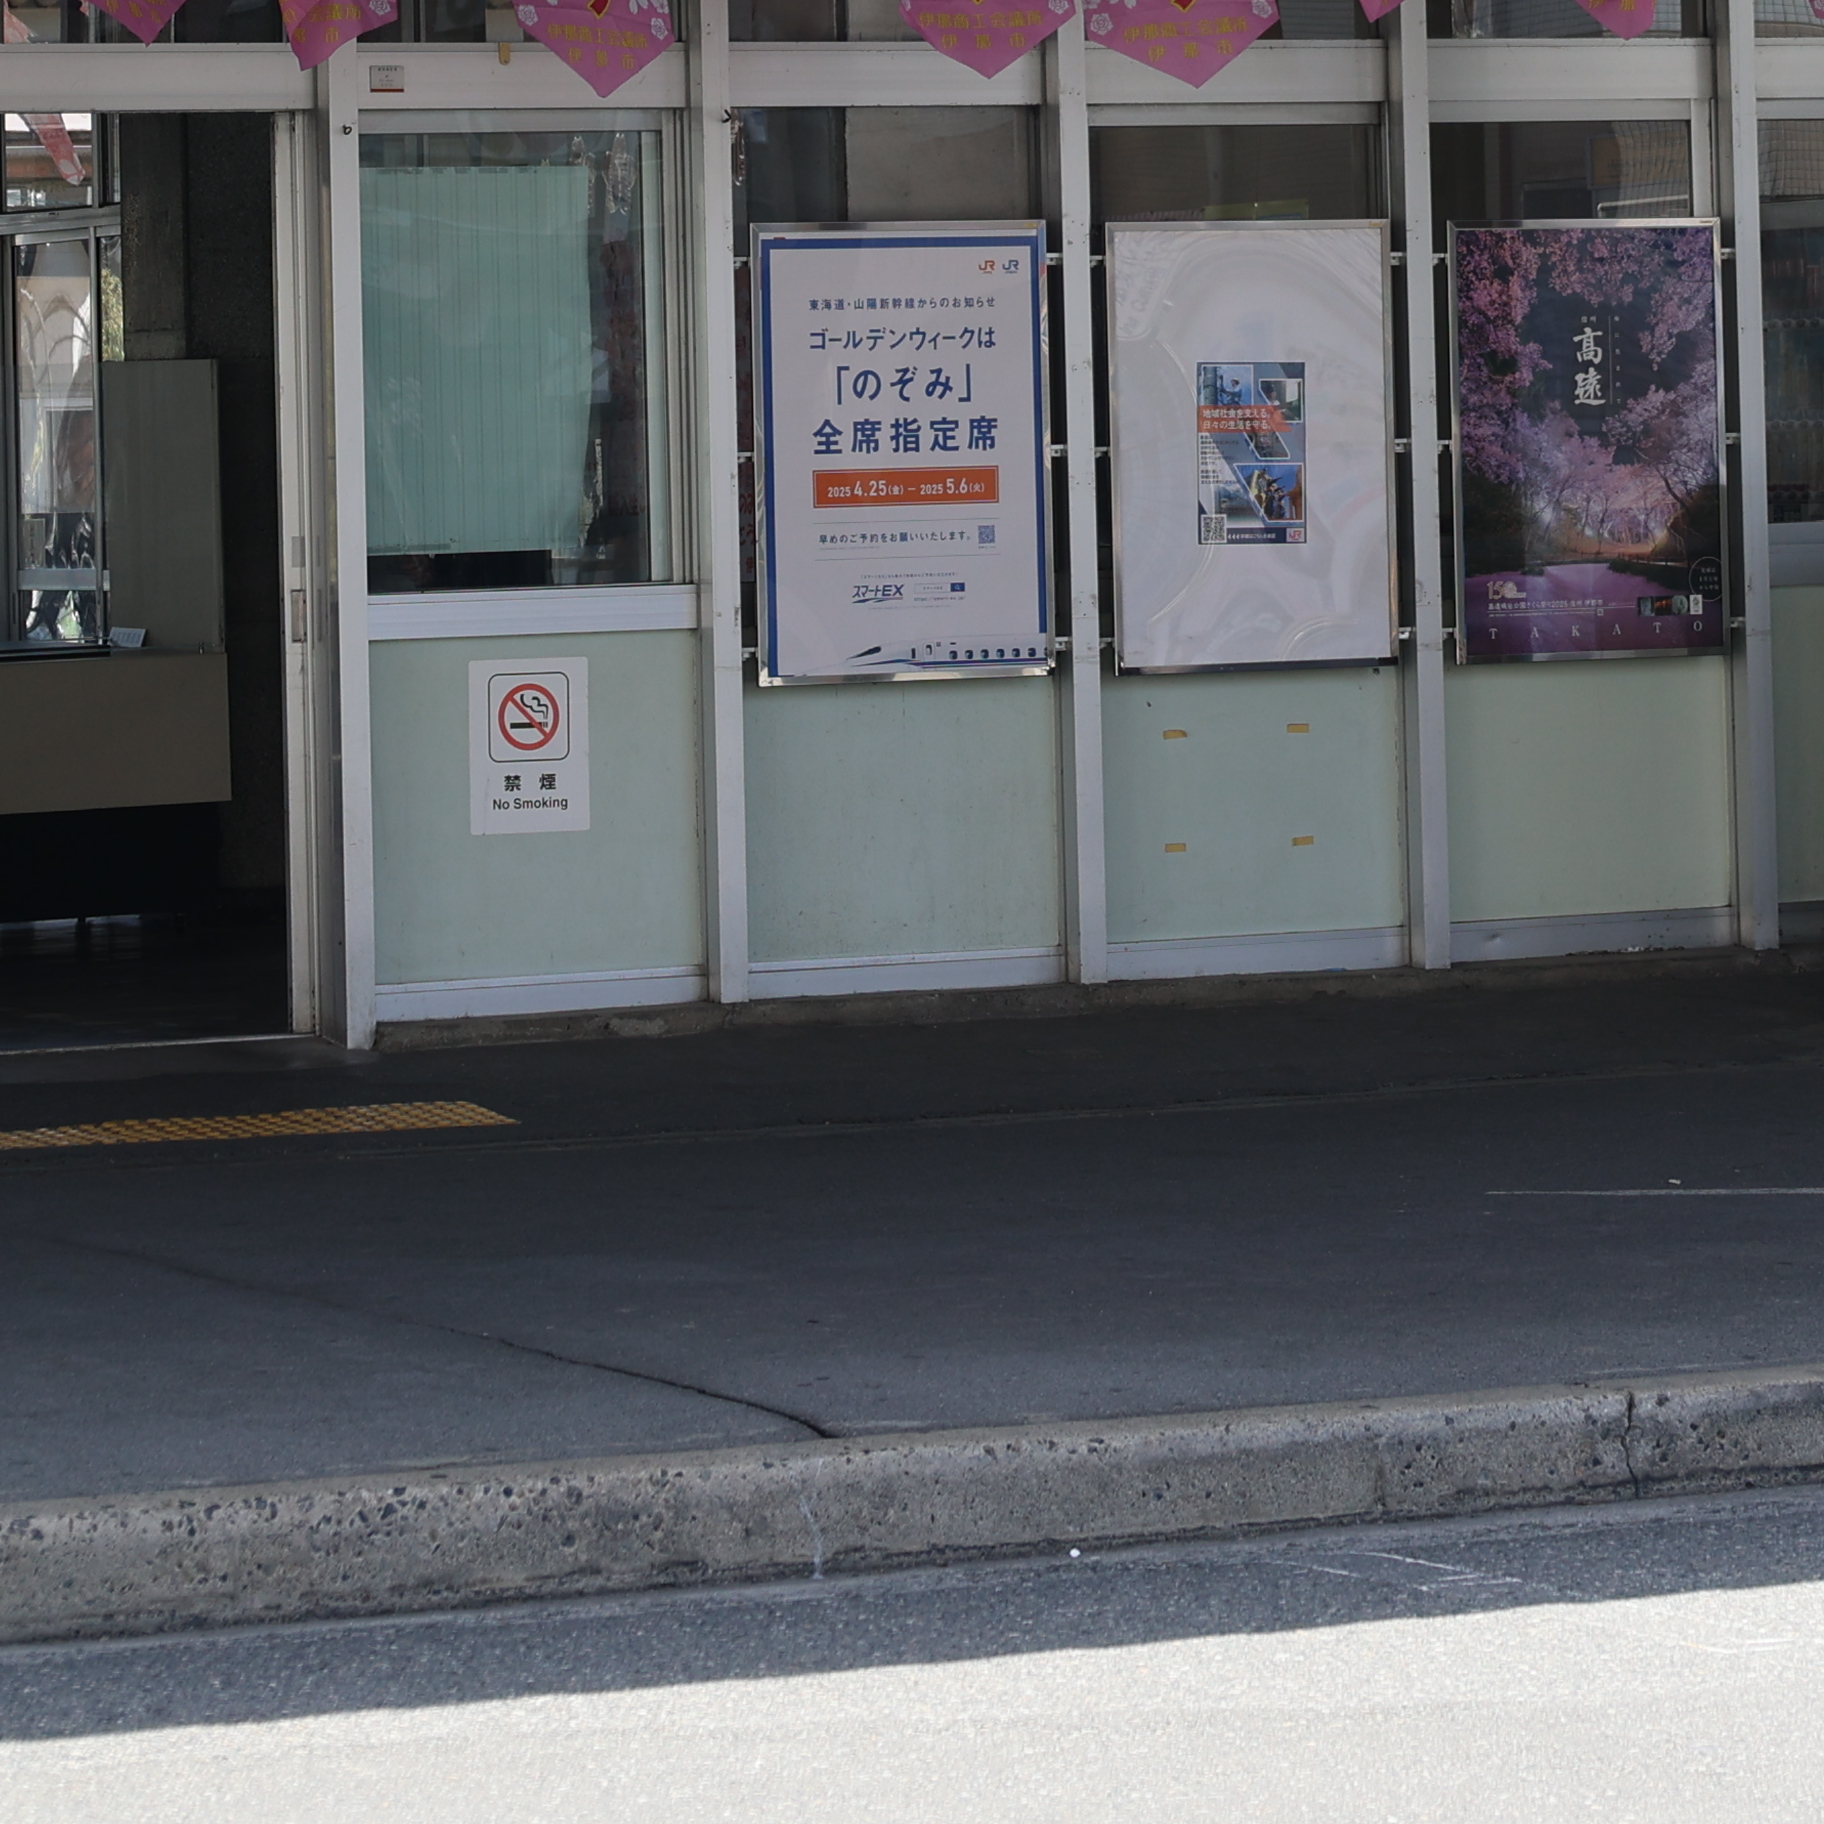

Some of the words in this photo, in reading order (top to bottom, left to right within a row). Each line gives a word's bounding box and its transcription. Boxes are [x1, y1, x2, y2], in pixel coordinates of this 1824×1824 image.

[918, 9, 1044, 30] 伊那商工会議所
[1122, 14, 1250, 44] 伊那商工会議所
[547, 23, 649, 50] 伊那商工会議所
[940, 32, 1026, 50] 伊那市
[568, 47, 637, 69] 伊那市
[1147, 38, 1234, 63] 伊那市
[978, 259, 995, 271] JR
[1002, 259, 1019, 271] JR
[809, 296, 996, 311] 東海道・山陽新幹線からのお知らせ
[809, 326, 997, 352] ゴールデンウィークは
[836, 363, 973, 406] 「のぞみ」
[812, 415, 999, 455] 全席指定席
[827, 486, 851, 498] 2025
[919, 484, 944, 496] 2025
[819, 529, 971, 544] 早めのご予約をお願いいたします。
[852, 583, 905, 598] スマートEX
[504, 773, 557, 792] 禁煙
[493, 798, 510, 810] No
[513, 796, 569, 811] Smoking
